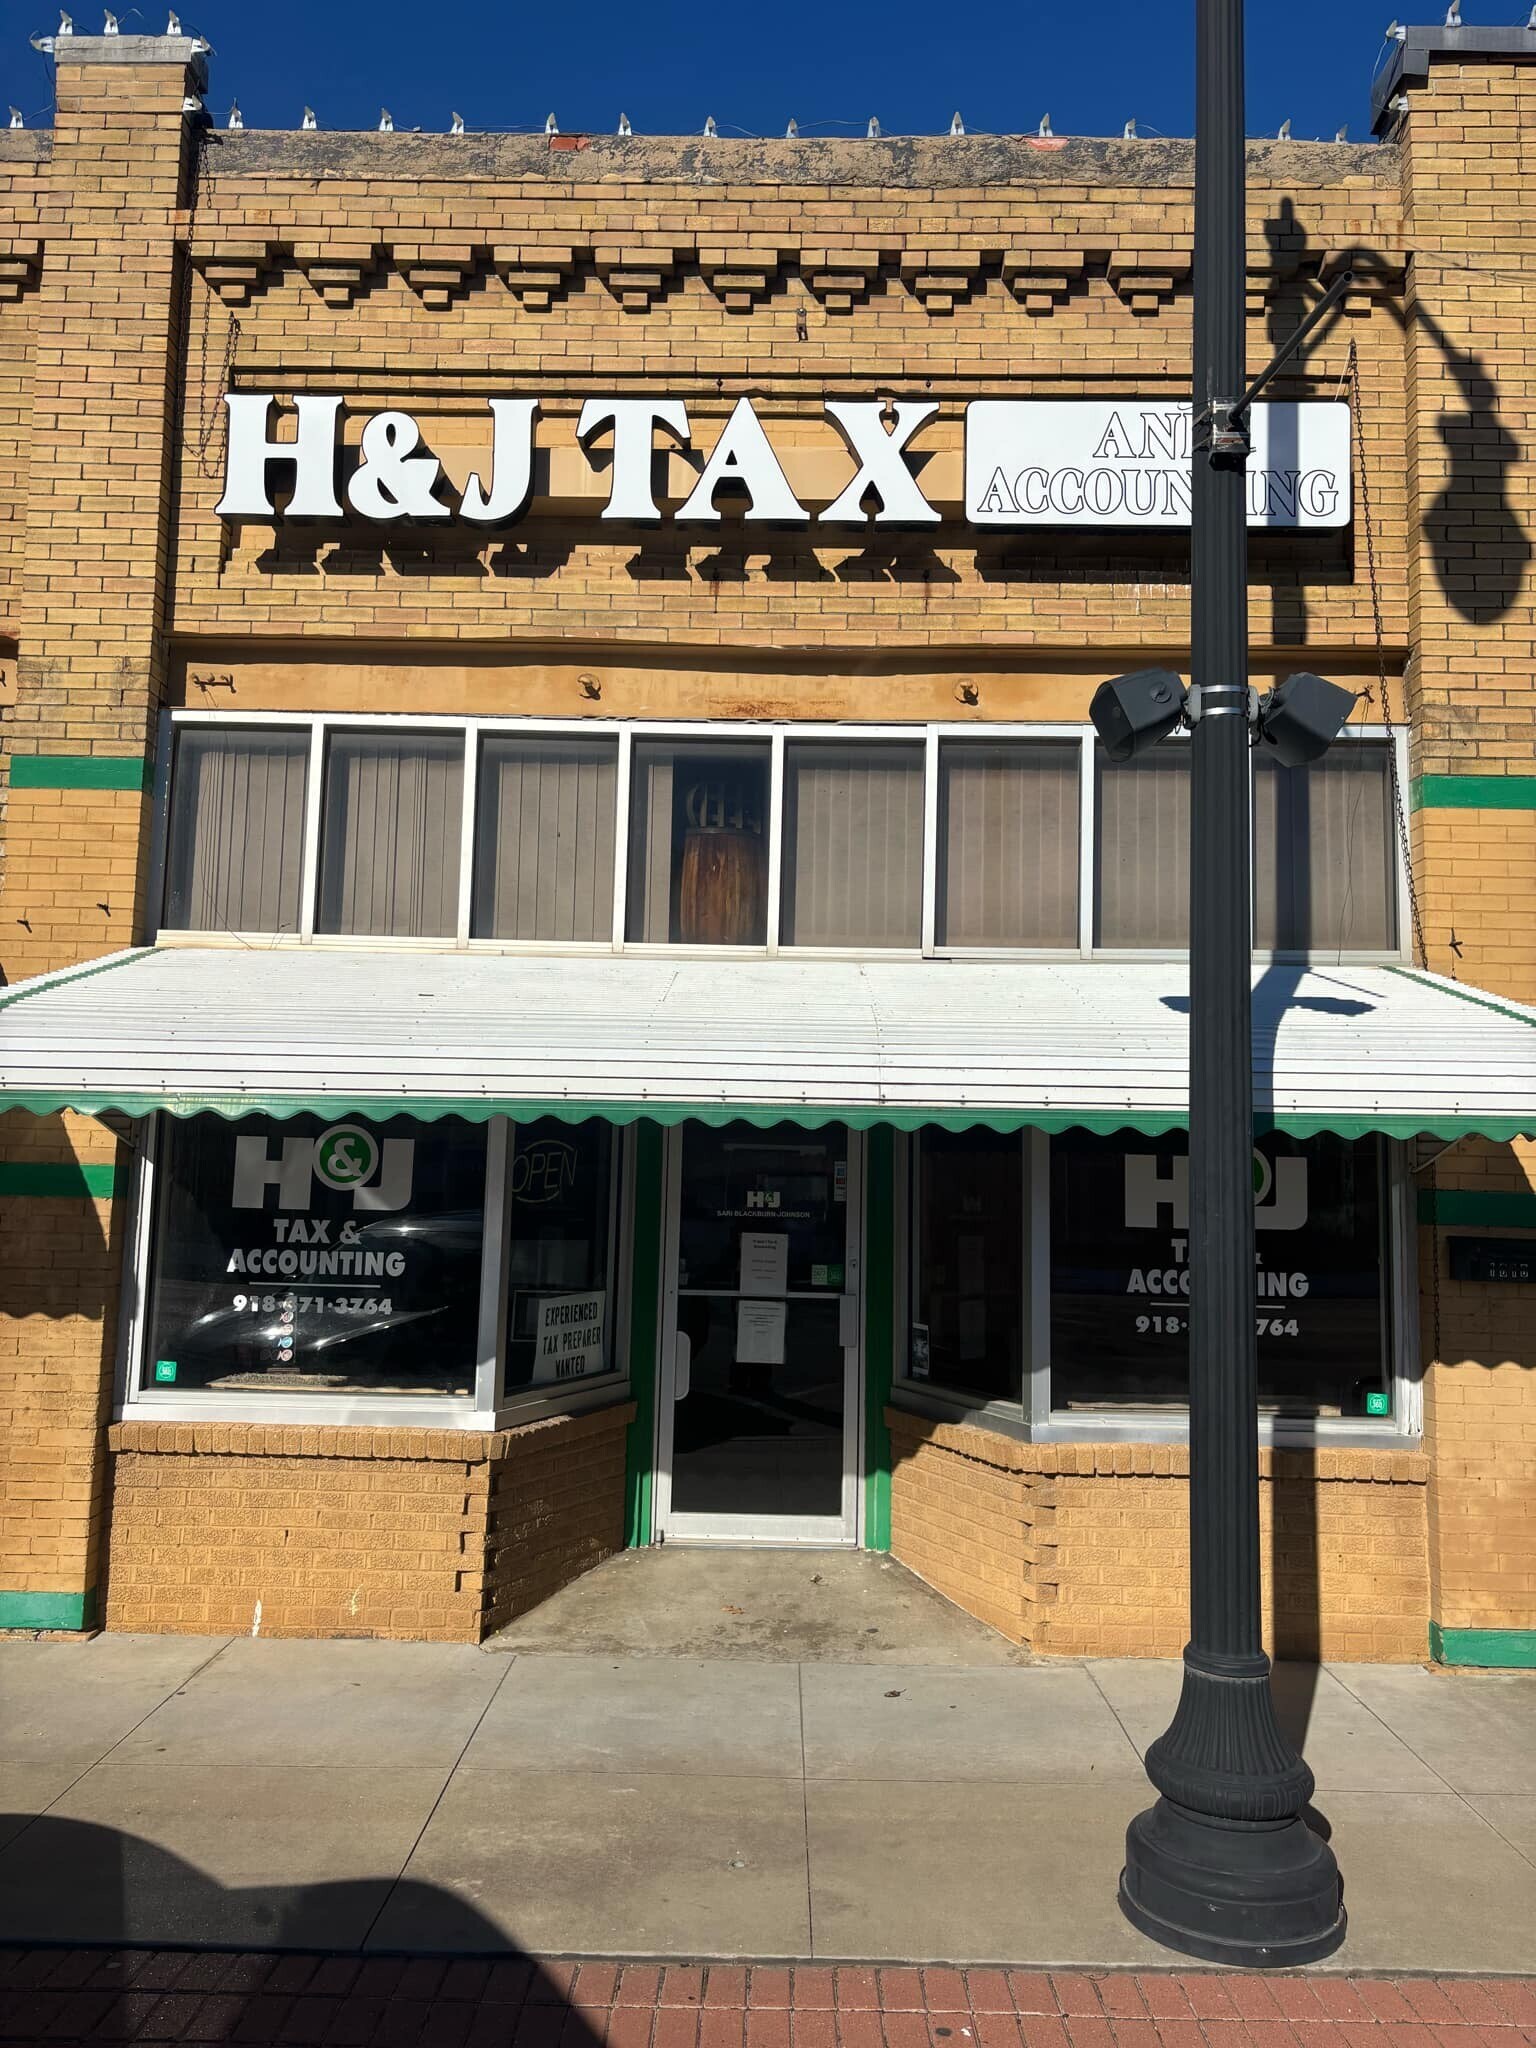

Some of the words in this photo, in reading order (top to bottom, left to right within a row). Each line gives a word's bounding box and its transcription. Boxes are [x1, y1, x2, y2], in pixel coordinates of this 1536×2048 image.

[1091, 411, 1193, 461] AN
[215, 393, 540, 522] H&J
[576, 396, 943, 523] TAX
[976, 465, 1340, 518] ACCOUNING
[231, 1123, 416, 1212] H&J
[512, 1148, 578, 1193] OPEN
[273, 1218, 331, 1244] TAX
[339, 1220, 362, 1245] &
[226, 1248, 407, 1277] ACCOUNTING
[1126, 1267, 1310, 1298] ACCOING
[544, 1301, 598, 1327] EXPERIENCED
[542, 1334, 559, 1356] TAX
[562, 1326, 601, 1353] PREPARER
[555, 1355, 586, 1378] WANTED
